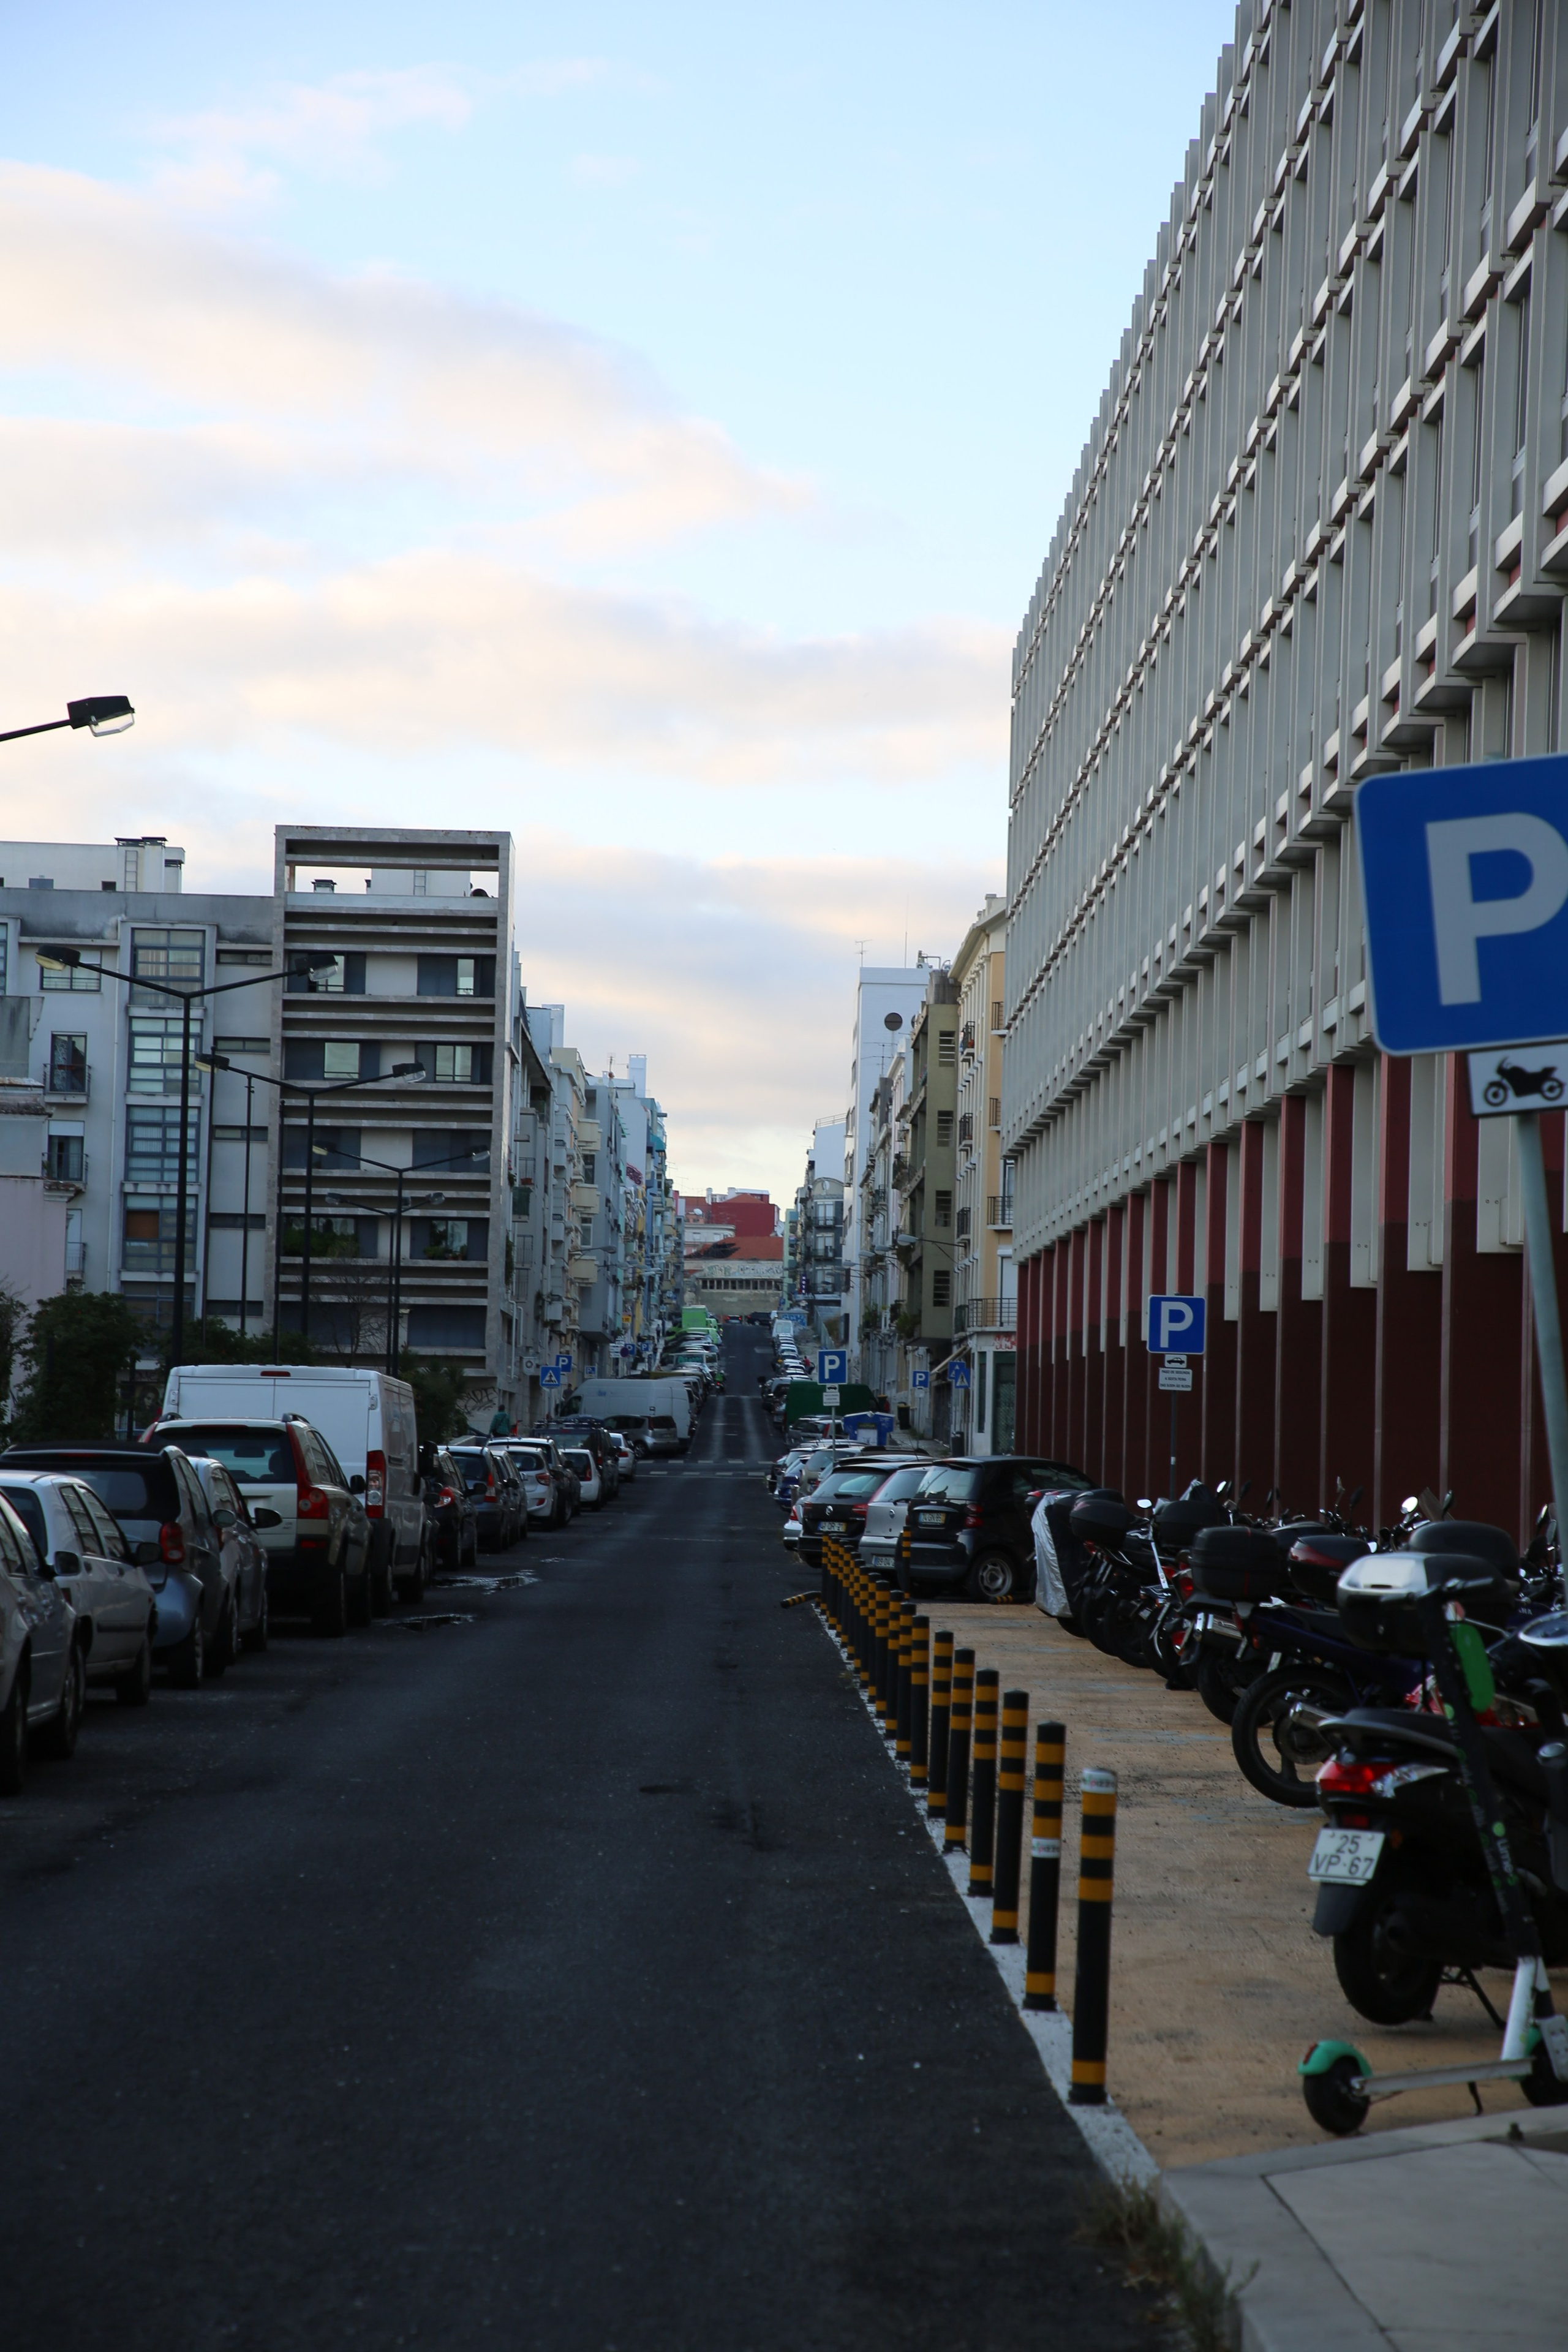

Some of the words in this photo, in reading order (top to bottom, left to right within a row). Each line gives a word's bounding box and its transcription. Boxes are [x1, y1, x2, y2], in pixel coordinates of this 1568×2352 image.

[1427, 812, 1568, 1005] P
[1159, 1301, 1194, 1348] P
[559, 1357, 569, 1370] P
[824, 1355, 840, 1380] P
[916, 1373, 925, 1385] P
[1336, 1834, 1362, 1854] 25
